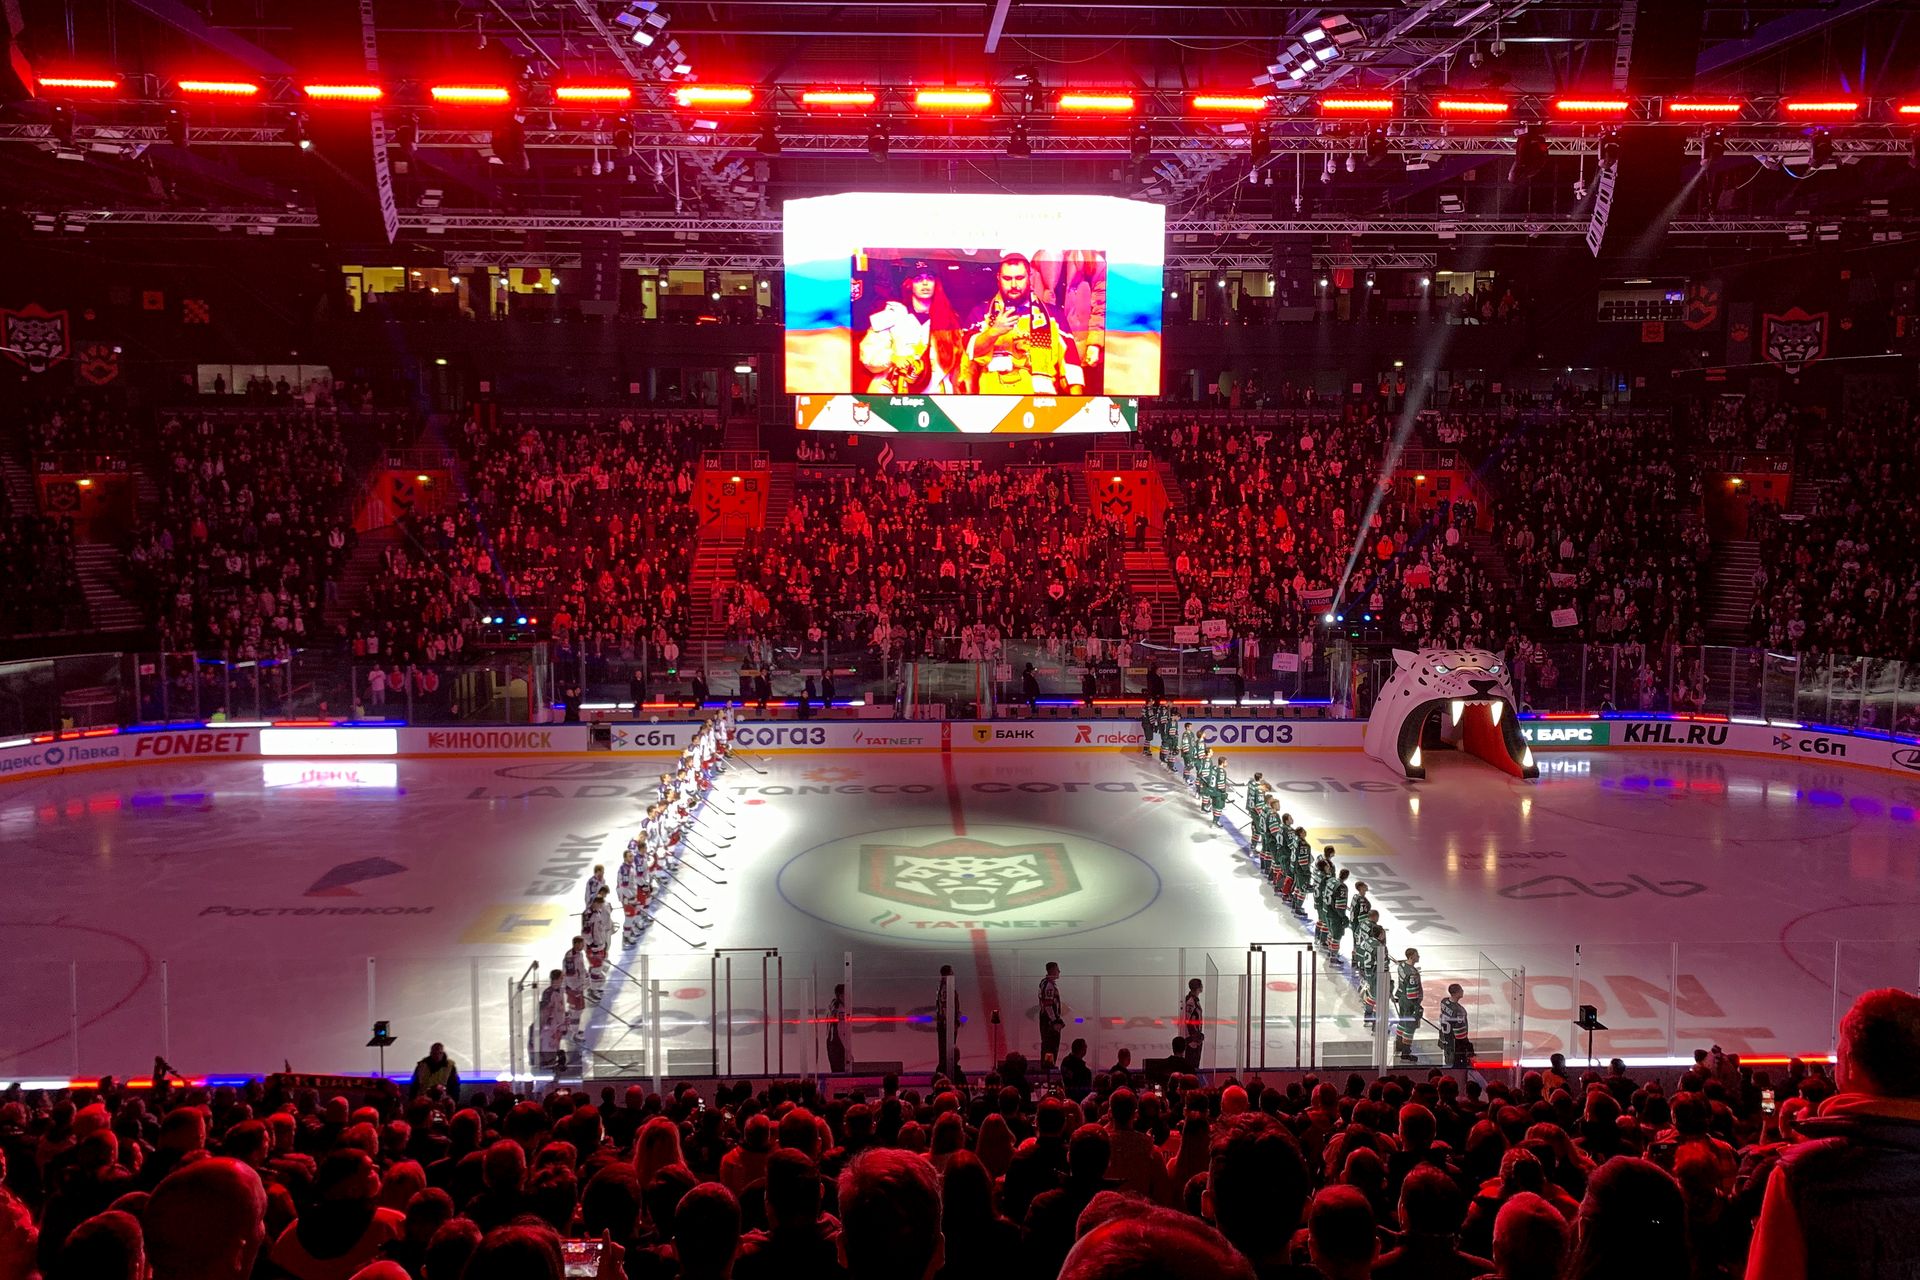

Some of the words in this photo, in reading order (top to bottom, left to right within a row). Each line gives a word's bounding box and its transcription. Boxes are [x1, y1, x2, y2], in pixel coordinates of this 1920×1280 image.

[918, 411, 930, 427] 0
[1023, 411, 1035, 427] 0
[896, 459, 982, 471] TANEFT
[428, 732, 552, 749] КИНОПОИСК
[634, 731, 675, 746] сбп
[865, 737, 923, 745] TATNEFT
[996, 730, 1035, 739] БАНК
[1097, 731, 1144, 744] rieker
[1537, 729, 1593, 741] БАРС
[1624, 723, 1729, 745] KHL.RU
[134, 733, 250, 757] FONBET
[1799, 737, 1846, 757] сбп
[68, 746, 120, 762] Лавка
[198, 905, 435, 916] Ростелеком
[907, 919, 1087, 929] TATNEFT
